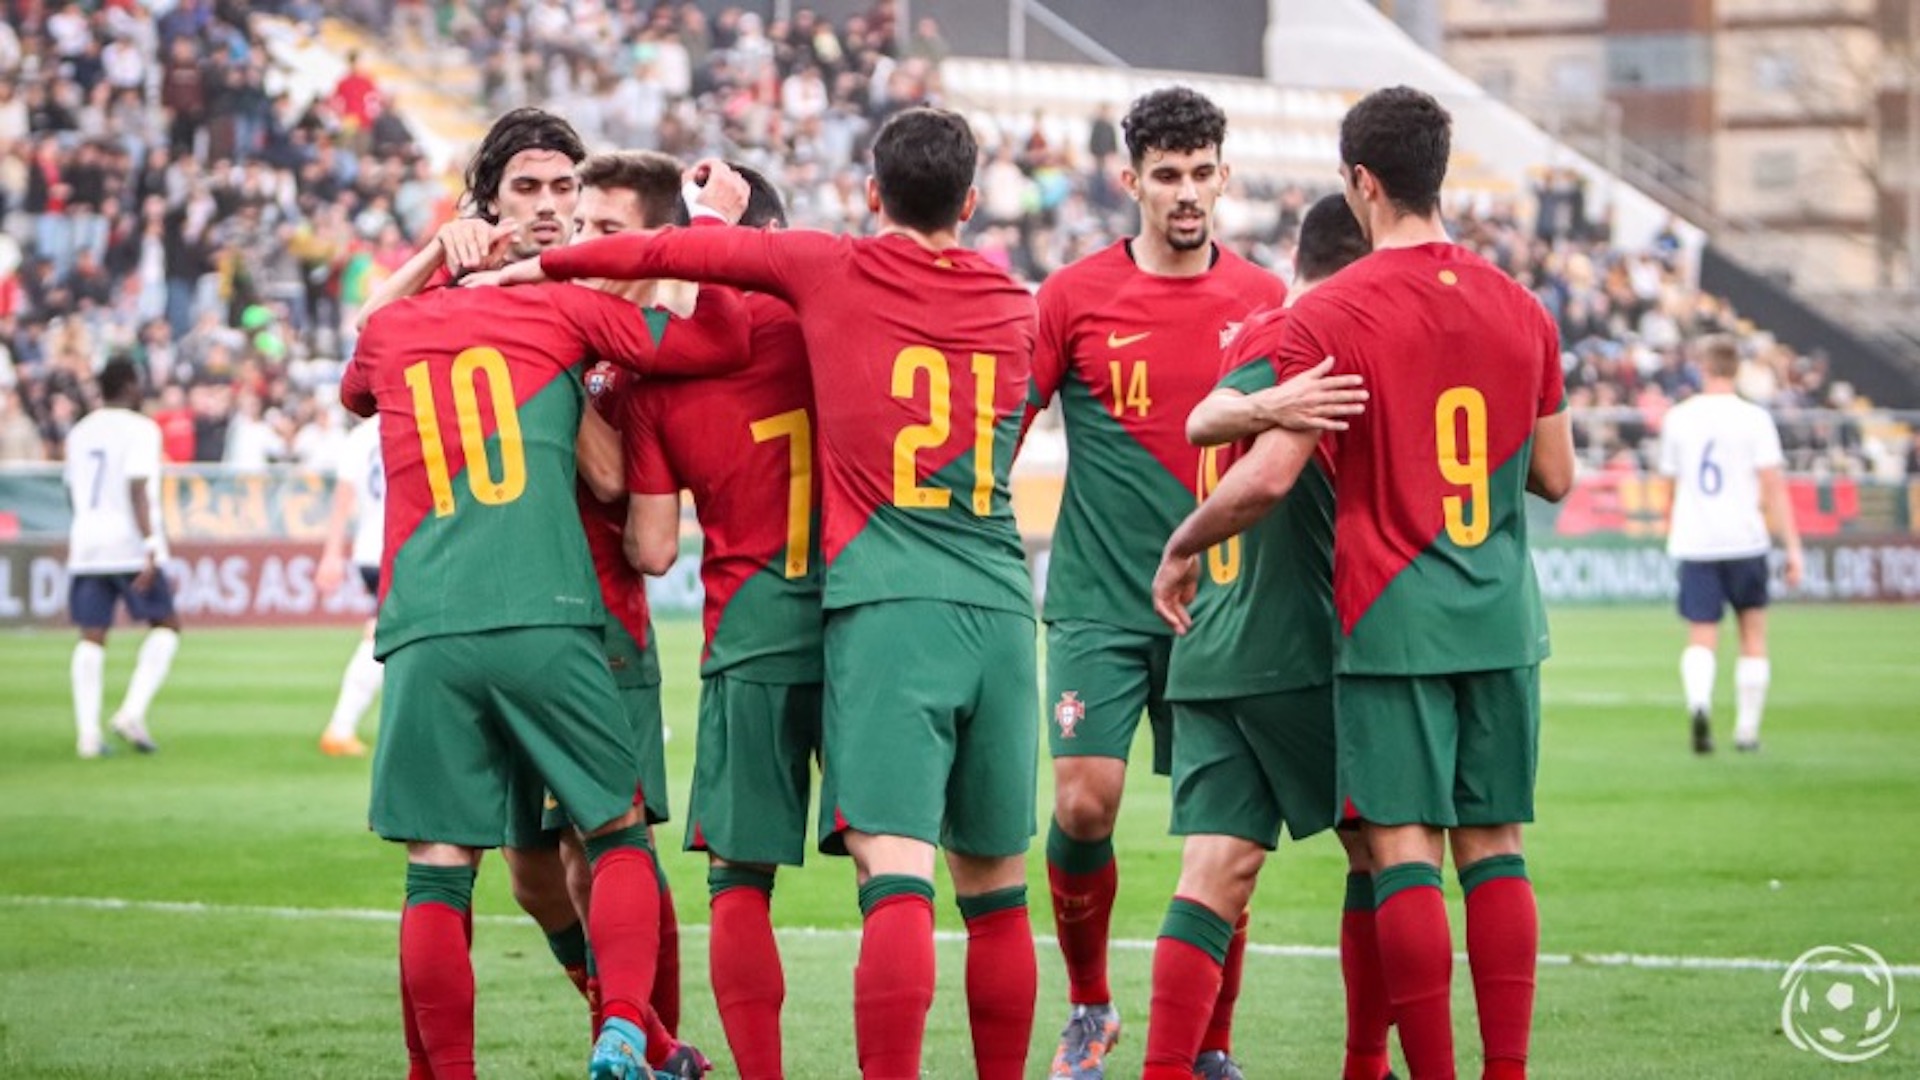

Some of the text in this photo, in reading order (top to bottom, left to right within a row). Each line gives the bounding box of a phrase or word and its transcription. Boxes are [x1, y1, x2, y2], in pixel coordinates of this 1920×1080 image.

[404, 345, 527, 518] 10
[891, 346, 997, 517] 21
[1109, 360, 1151, 417] 14
[89, 449, 106, 509] 7
[750, 408, 811, 579] 7
[1435, 386, 1490, 547] 9
[1699, 437, 1722, 497] 6
[254, 555, 315, 615] AS
